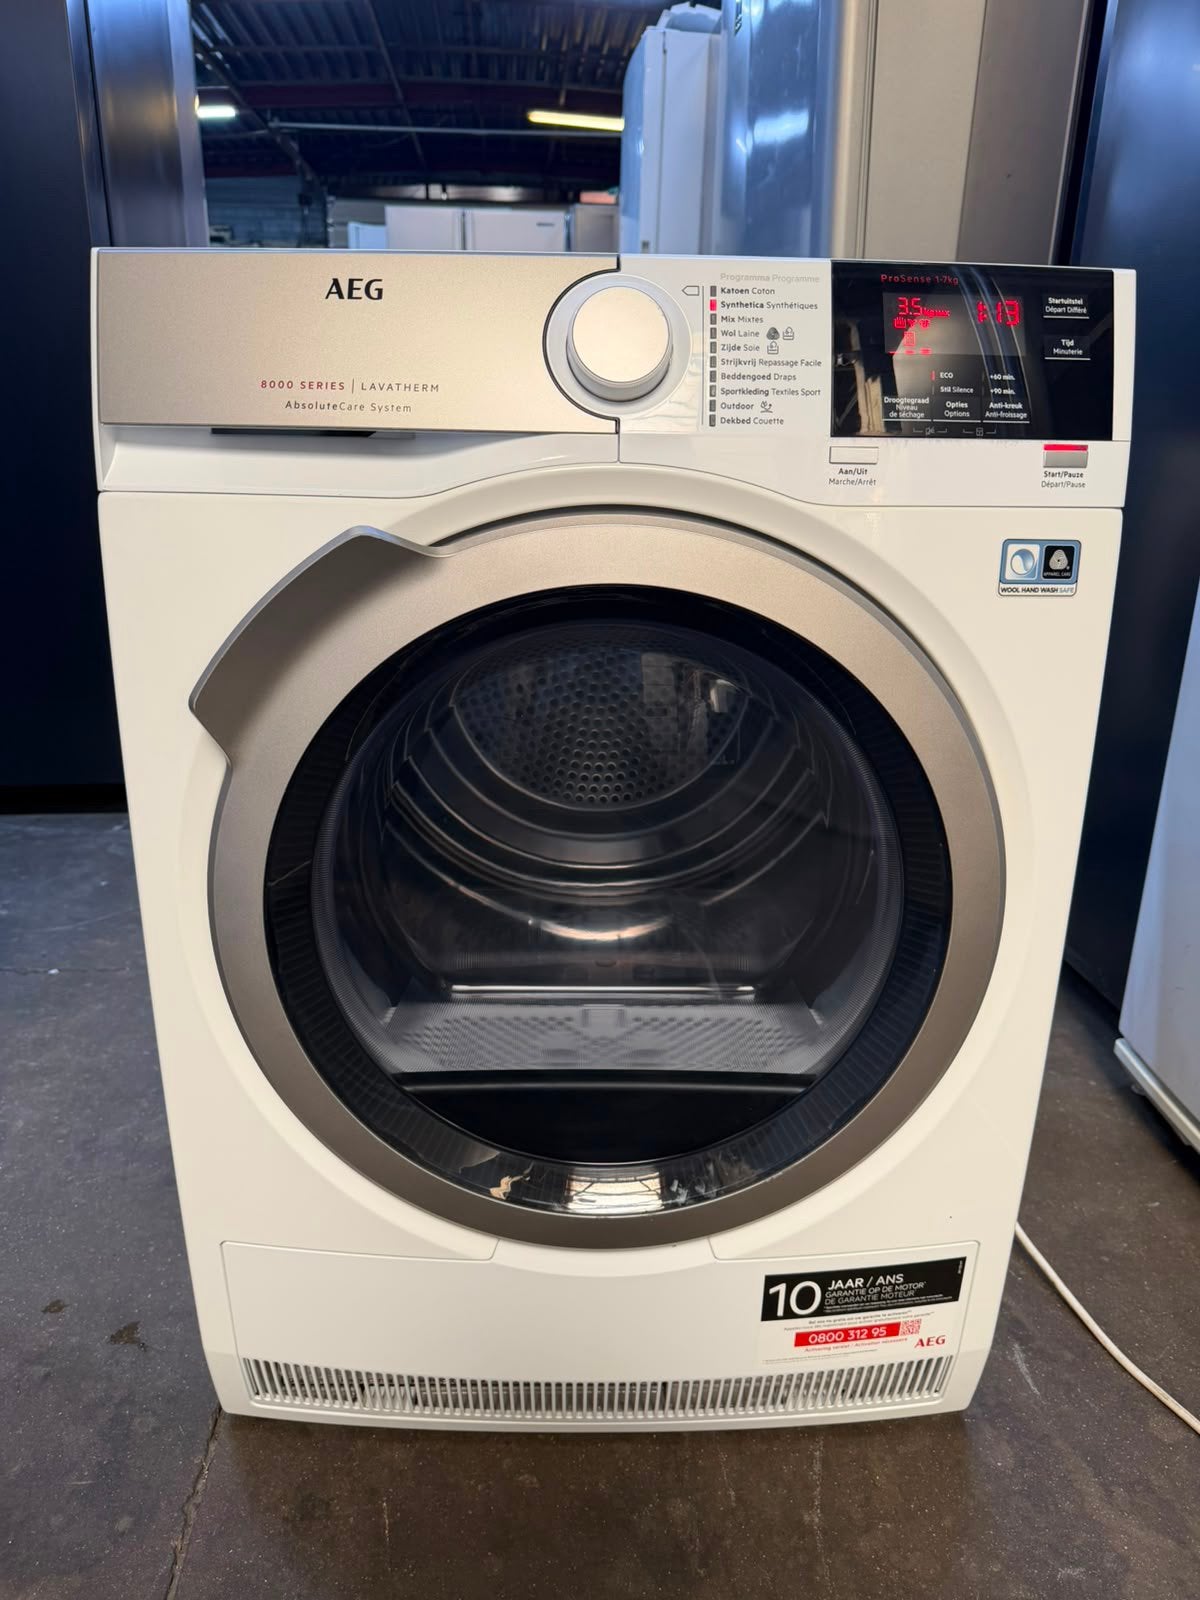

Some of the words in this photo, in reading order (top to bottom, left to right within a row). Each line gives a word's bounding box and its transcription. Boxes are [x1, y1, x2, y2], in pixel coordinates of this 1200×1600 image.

[720, 273, 770, 282] Programma
[772, 274, 820, 283] Programme
[881, 274, 931, 283] ProSense
[325, 278, 384, 300] AEG
[751, 287, 775, 295] Coton
[1048, 297, 1083, 305] Startuitstel
[721, 301, 764, 310] Synthetica
[766, 301, 818, 310] Synthétiques
[1045, 306, 1066, 314] Départ
[721, 329, 736, 337] Wol
[721, 344, 741, 352] Zijde
[721, 358, 756, 367] Strijkvrij
[759, 359, 798, 367] Repassage
[800, 359, 822, 367] Facile
[721, 373, 771, 382] Beddengoed
[773, 373, 796, 381] Draps
[260, 380, 294, 390] 8000
[300, 381, 345, 391] SERIES
[361, 383, 439, 392] LAVATHERM
[720, 388, 769, 397] Sportkleding
[771, 388, 799, 396] Textiles
[801, 388, 821, 396] Sport
[884, 397, 929, 405] Droogtegraad
[946, 401, 968, 409] Opties
[285, 401, 365, 411] AbsoluteCare
[370, 403, 412, 413] System
[720, 402, 754, 410] Outdoor
[899, 411, 925, 419] séchage
[944, 410, 970, 418] Options
[985, 411, 1027, 419] Anti-froissage
[753, 417, 784, 425] Couette
[838, 467, 868, 475] Aan/Uit
[829, 478, 876, 486] Marche/Arrêt
[1041, 480, 1086, 488] Départ/Pause
[828, 1278, 864, 1290] JAAR
[866, 1276, 873, 1288] /
[875, 1273, 904, 1286] ANS
[825, 1288, 867, 1298] GARANTIE
[868, 1286, 880, 1295] OP
[881, 1285, 893, 1293] DE
[769, 1281, 822, 1317] 10
[837, 1294, 879, 1305] GARANTIE
[808, 1331, 844, 1344] 0800
[847, 1328, 868, 1340] 312
[871, 1326, 887, 1336] 95
[914, 1335, 946, 1348] AEG
